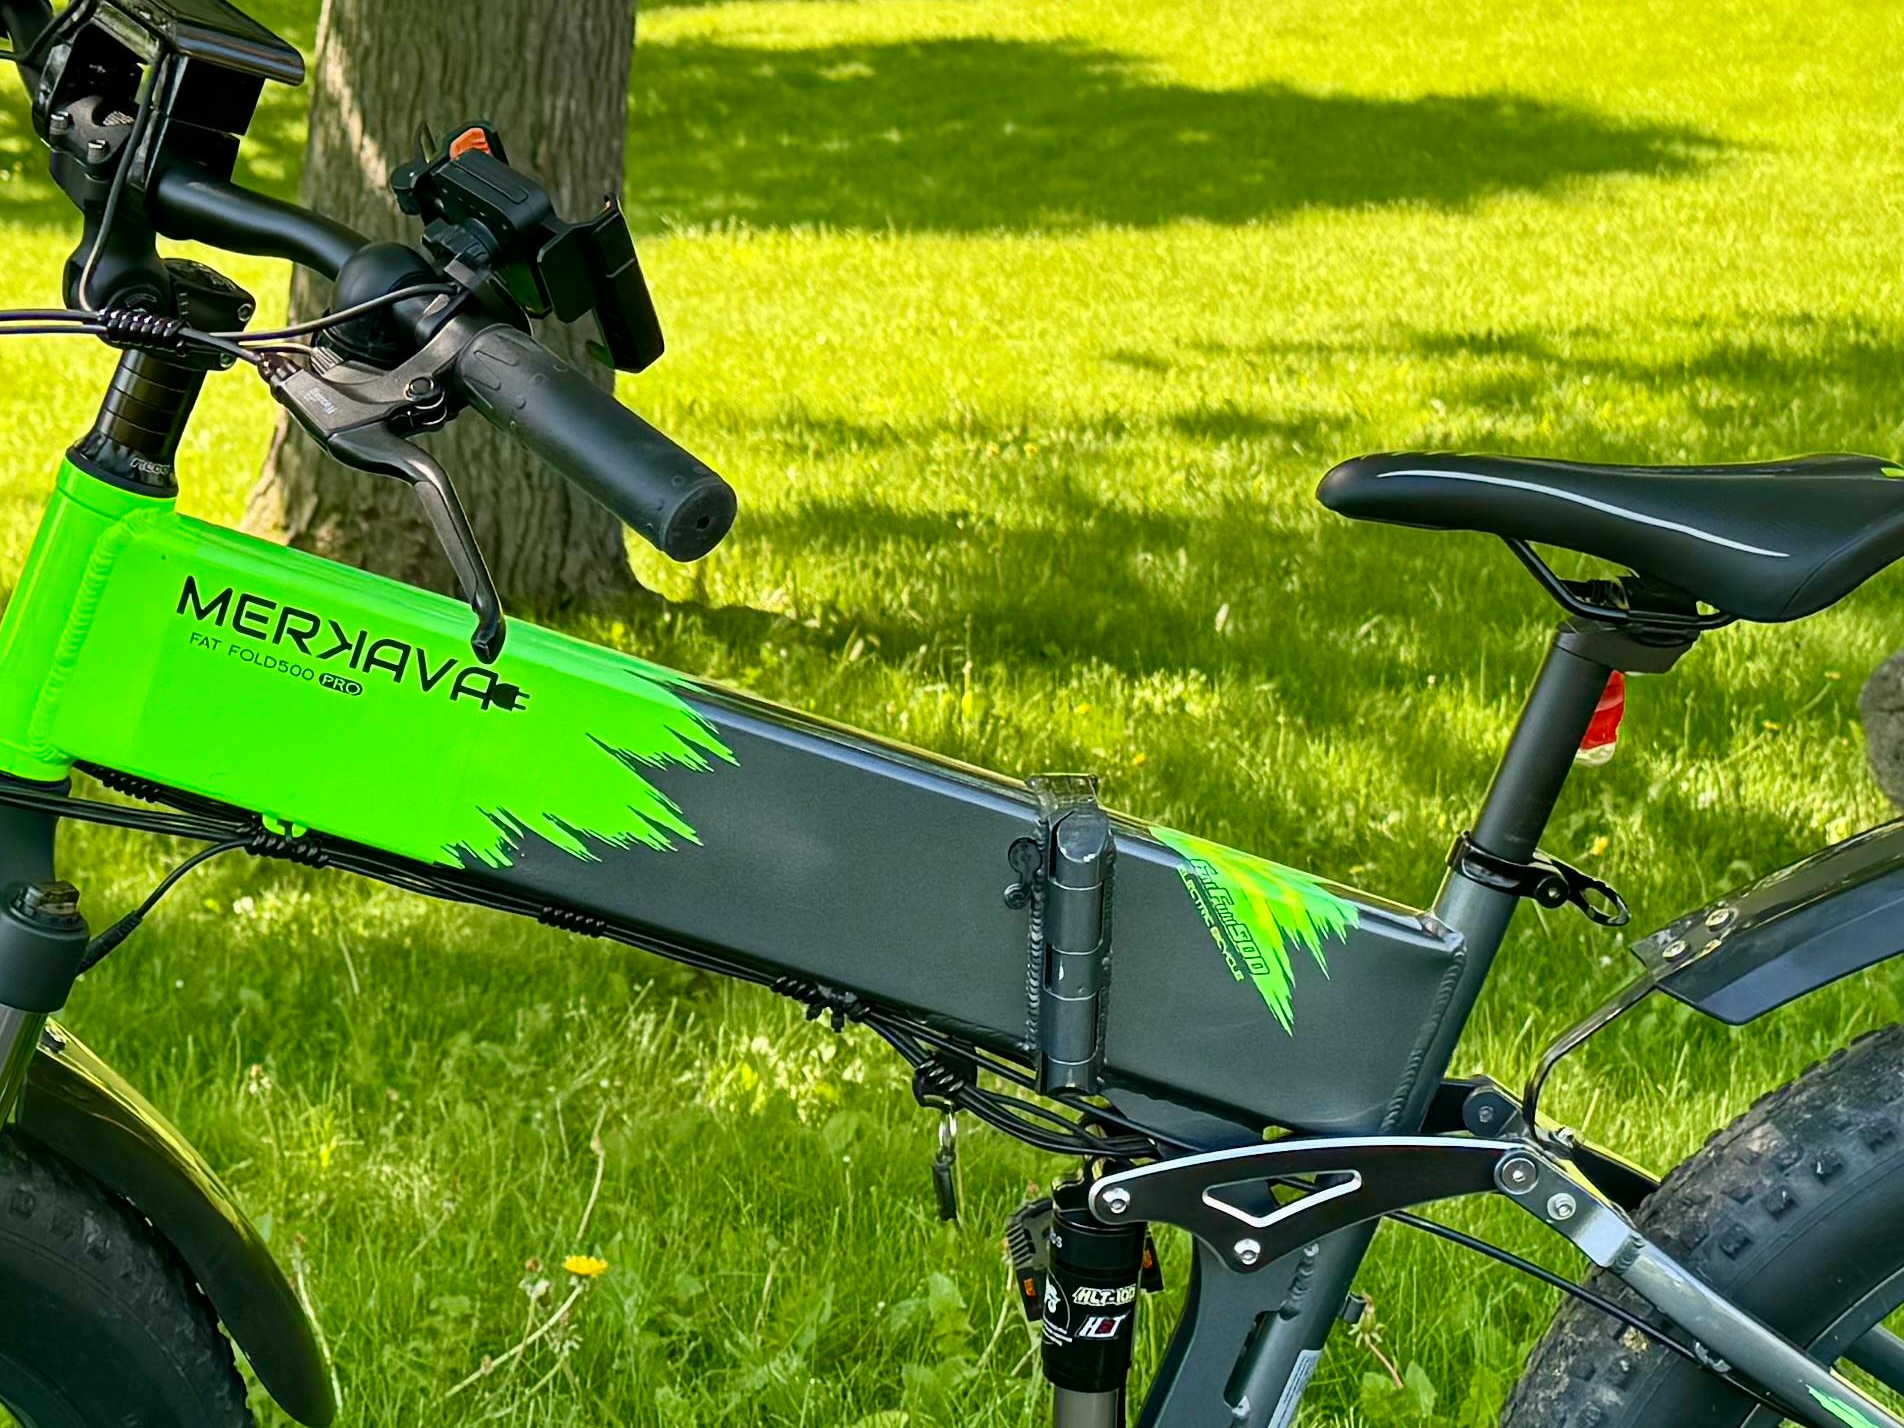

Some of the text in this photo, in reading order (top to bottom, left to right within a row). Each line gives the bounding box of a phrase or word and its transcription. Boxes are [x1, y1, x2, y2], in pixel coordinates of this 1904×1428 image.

[176, 574, 500, 711] MERKAVA
[189, 631, 361, 696] FAT FOLD500 PRO
